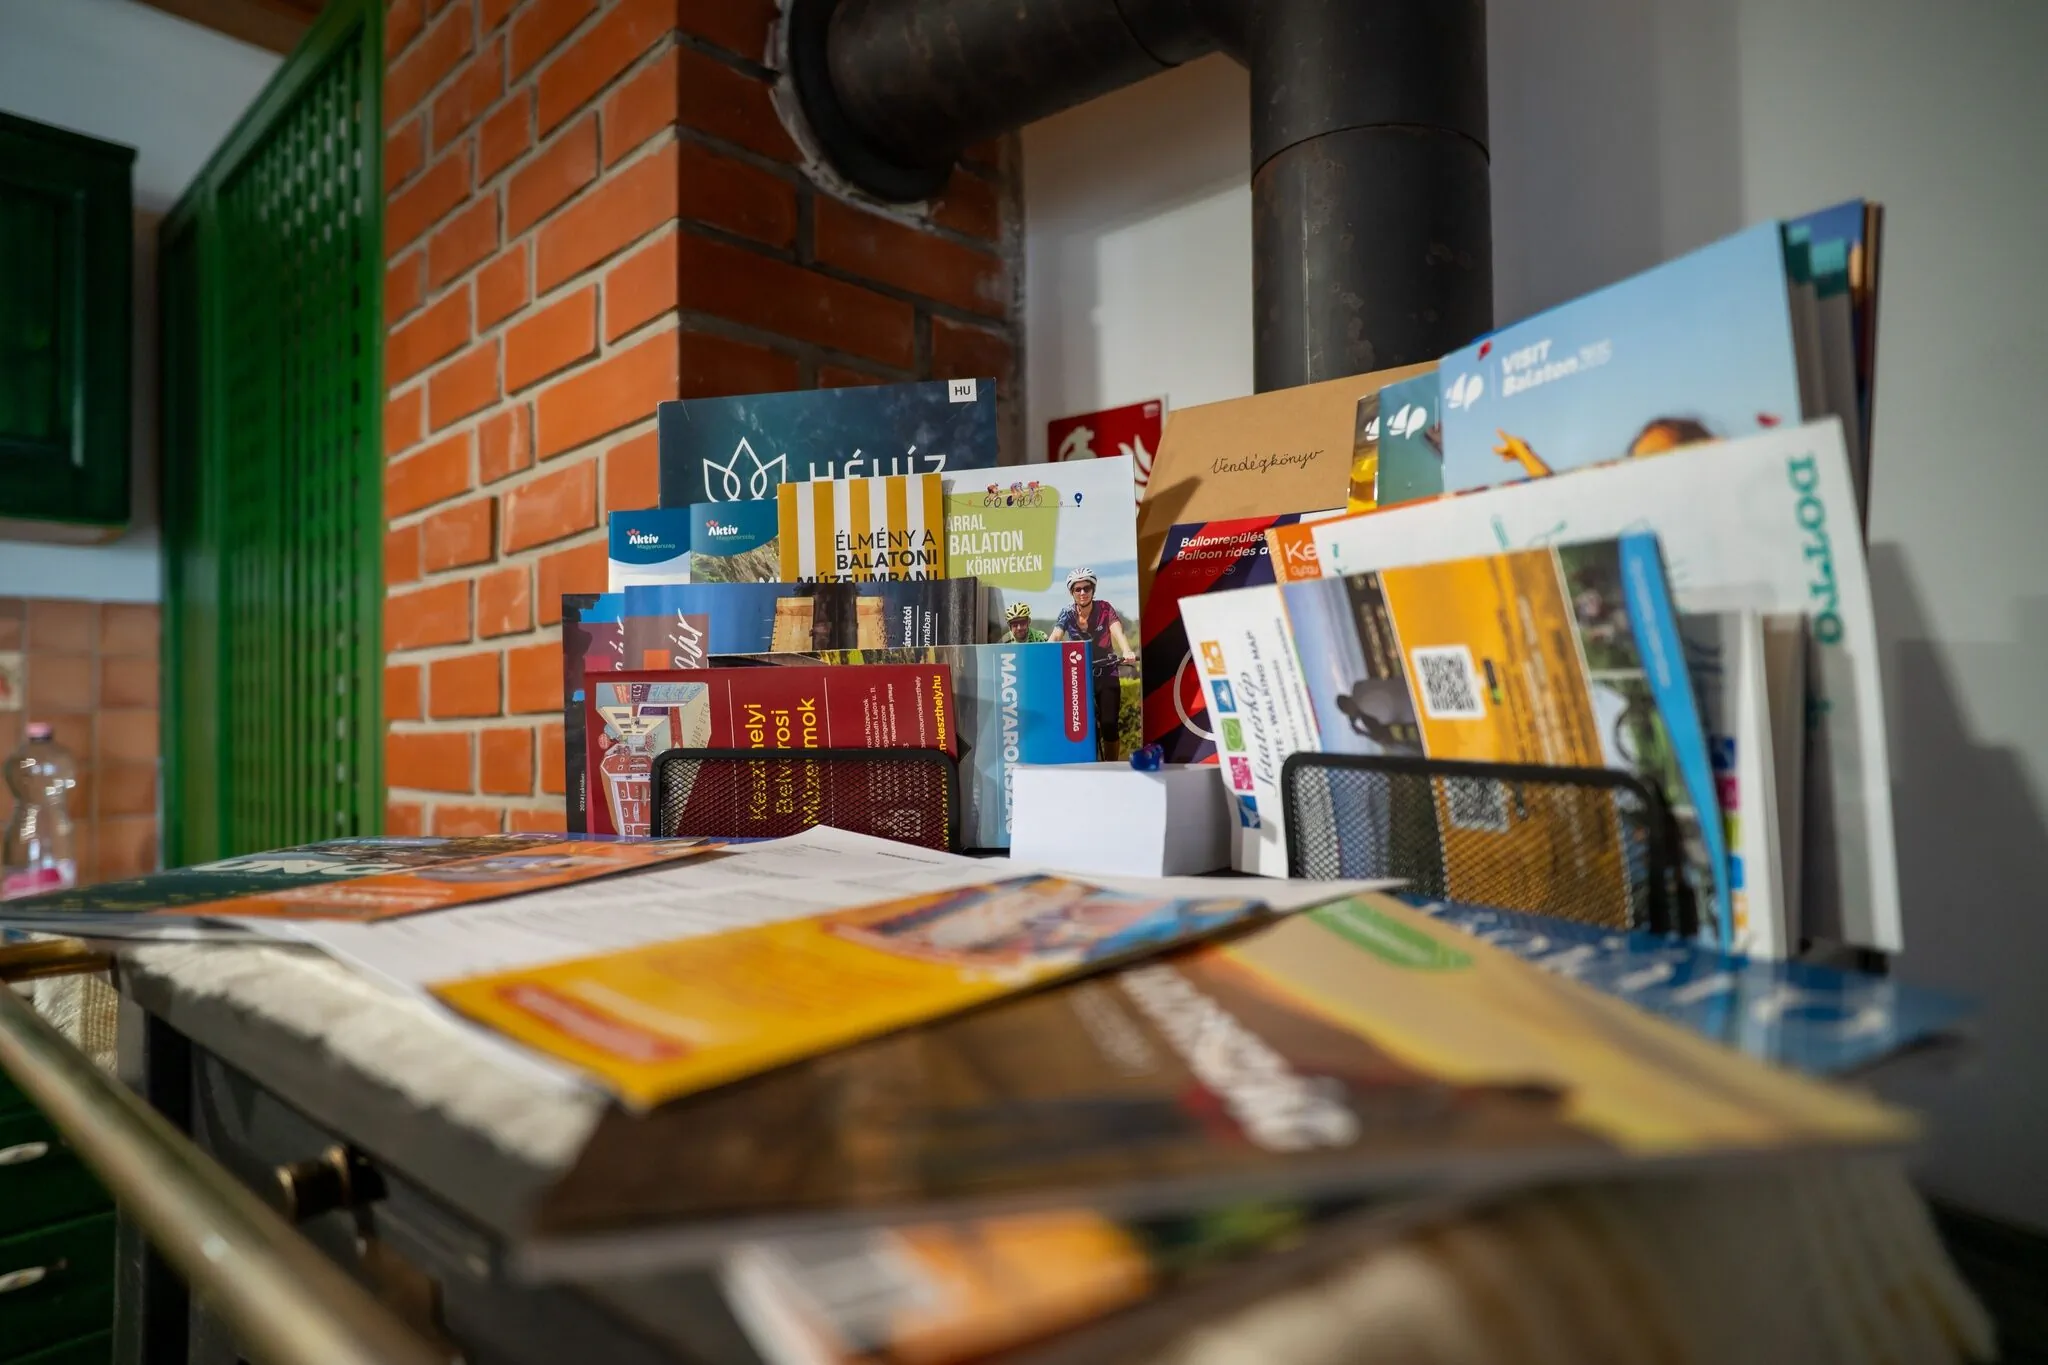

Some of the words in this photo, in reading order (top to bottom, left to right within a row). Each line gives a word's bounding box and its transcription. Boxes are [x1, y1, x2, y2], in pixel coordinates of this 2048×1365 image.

[955, 386, 971, 395] HU
[1210, 450, 1324, 474] Vendégkönyv
[629, 533, 659, 545] Aktív
[708, 524, 739, 536] Aktív
[836, 527, 916, 551] ÉLMÉNY
[922, 531, 936, 546] A
[950, 529, 1023, 556] BALATON
[1177, 549, 1222, 561] Balloon
[1225, 546, 1256, 558] rides
[1786, 453, 1845, 645] DOTTO
[837, 549, 937, 570] BALATONI
[966, 552, 1043, 576] KÖRNYÉKÉN
[1071, 666, 1080, 732] MAGYARORSZÁG
